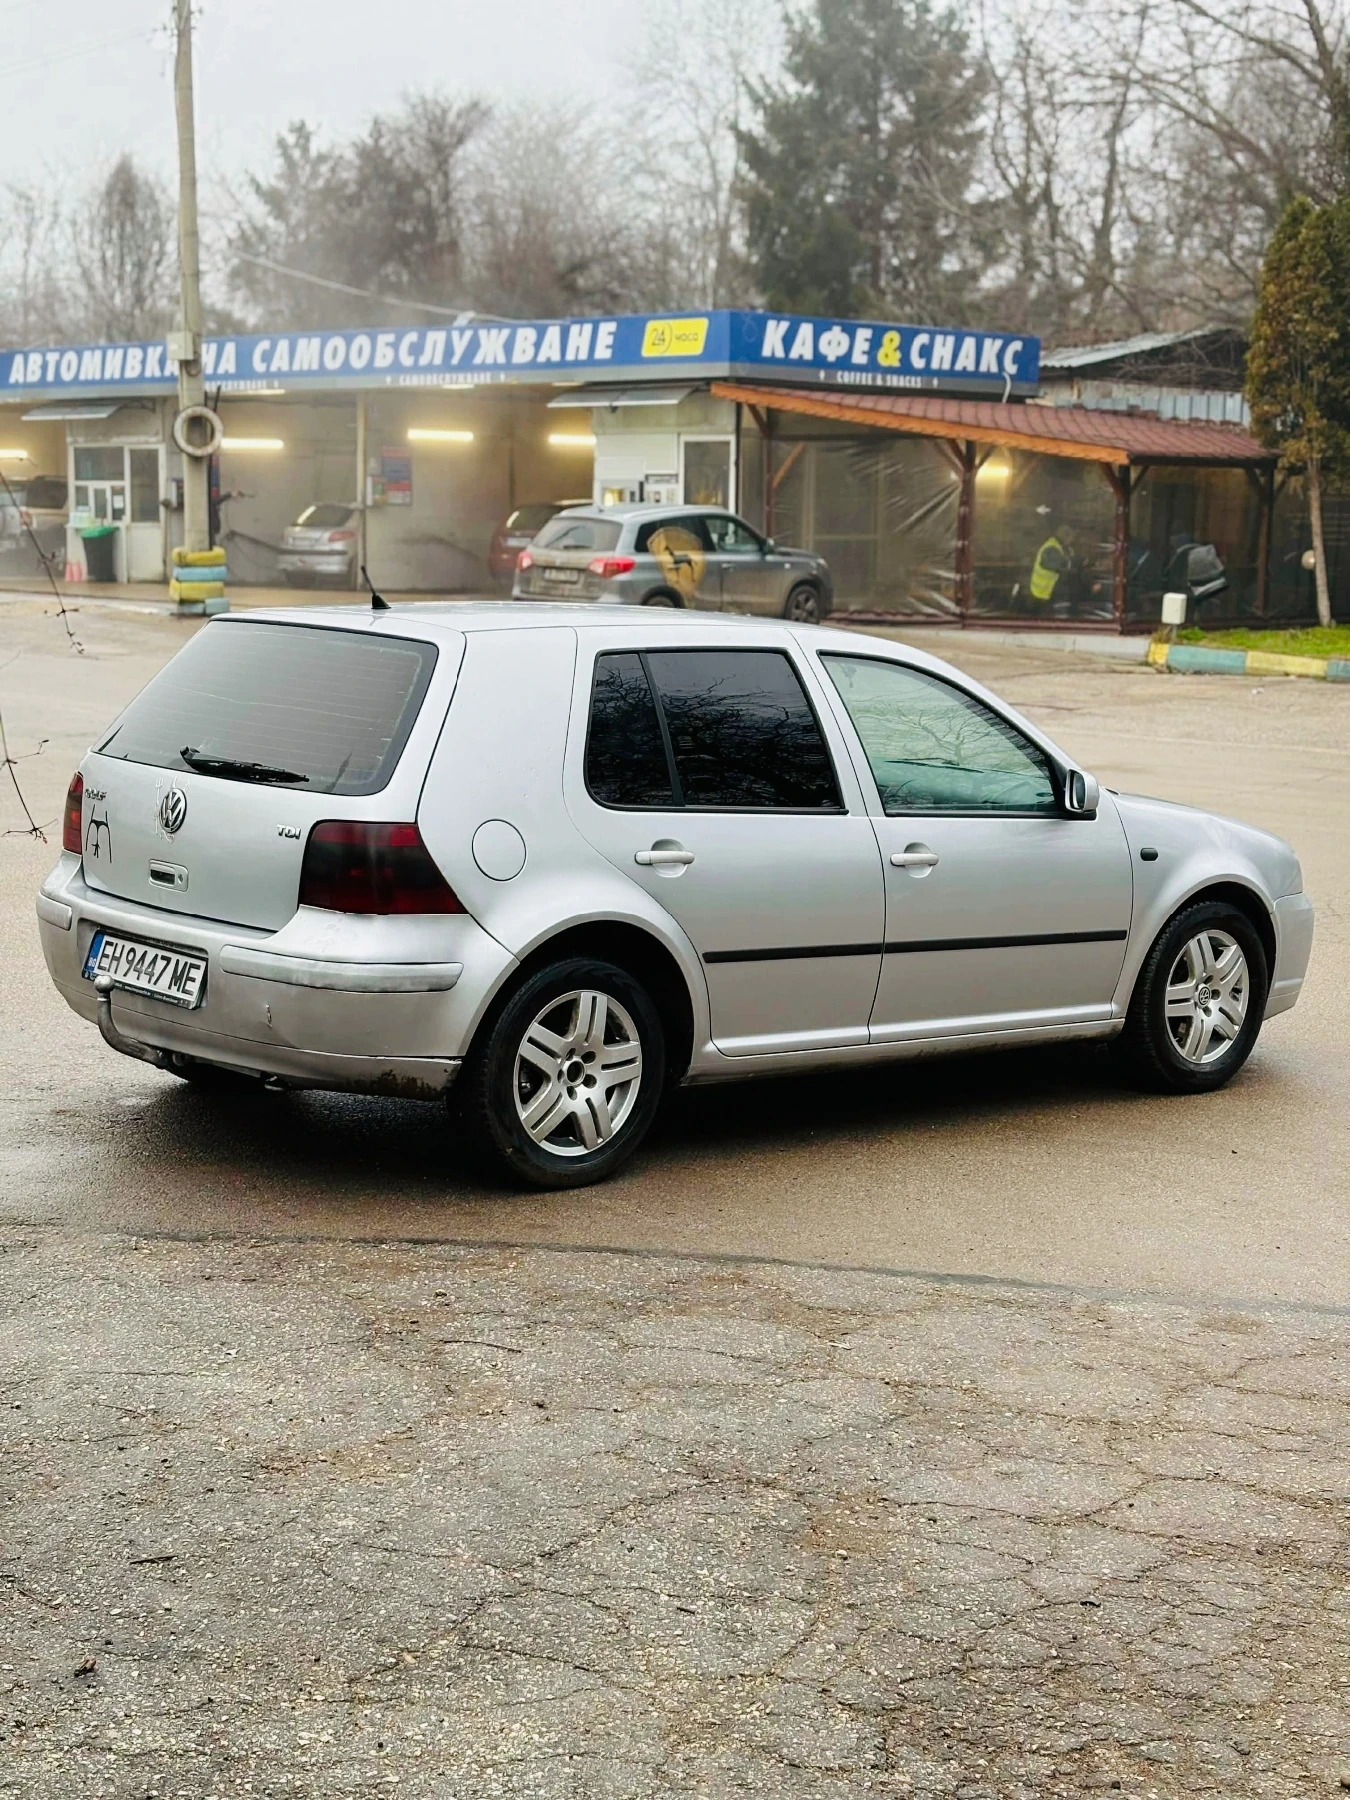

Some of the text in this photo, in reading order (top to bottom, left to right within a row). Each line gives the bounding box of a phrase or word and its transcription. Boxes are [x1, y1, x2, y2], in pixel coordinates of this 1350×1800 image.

[651, 327, 666, 347] 24
[761, 319, 1024, 375] КАФЕ & СНАКС
[202, 342, 237, 374] НА
[252, 321, 618, 373] САМООБСЛУЖВАНЕ
[836, 370, 873, 386] COFFEE
[276, 823, 302, 840] TDI
